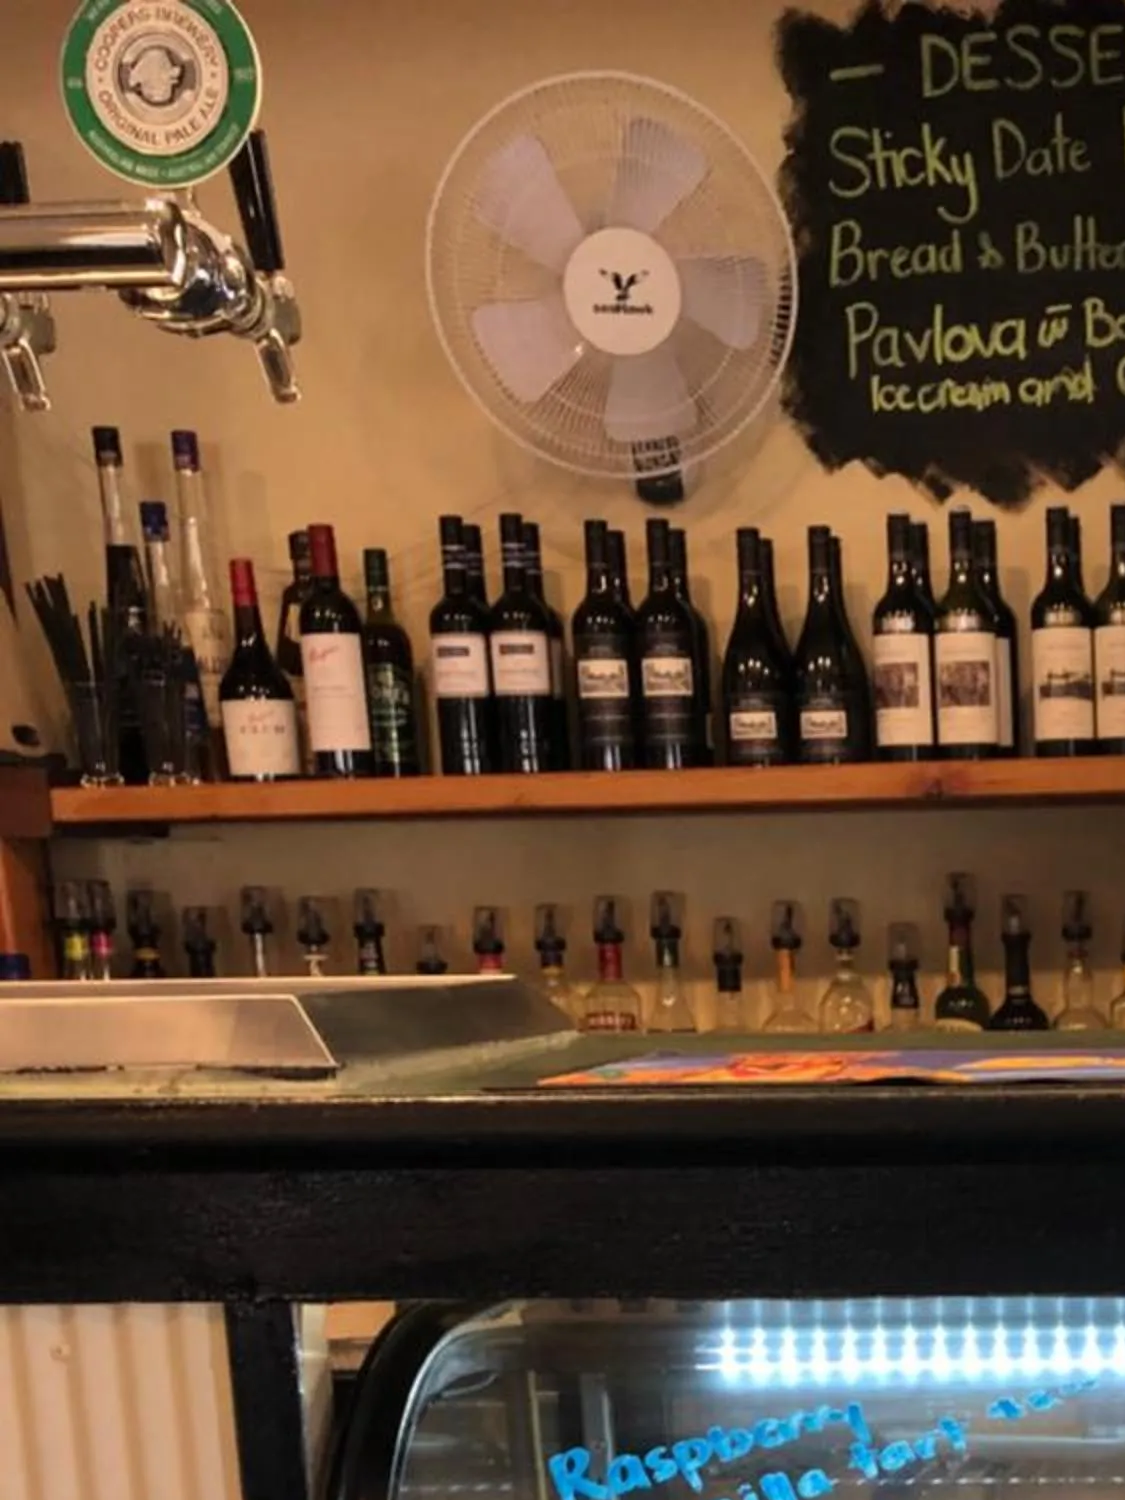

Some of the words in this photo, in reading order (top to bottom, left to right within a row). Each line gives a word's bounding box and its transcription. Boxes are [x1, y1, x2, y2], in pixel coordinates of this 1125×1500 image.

[95, 8, 150, 71] COOPERS
[98, 90, 159, 146] ORIGINAL
[164, 118, 204, 146] PALE
[829, 123, 979, 224] Sticky
[992, 113, 1091, 178] Date
[828, 218, 963, 288] Bread
[846, 300, 1027, 379] Pavlova
[1018, 360, 1095, 405] and
